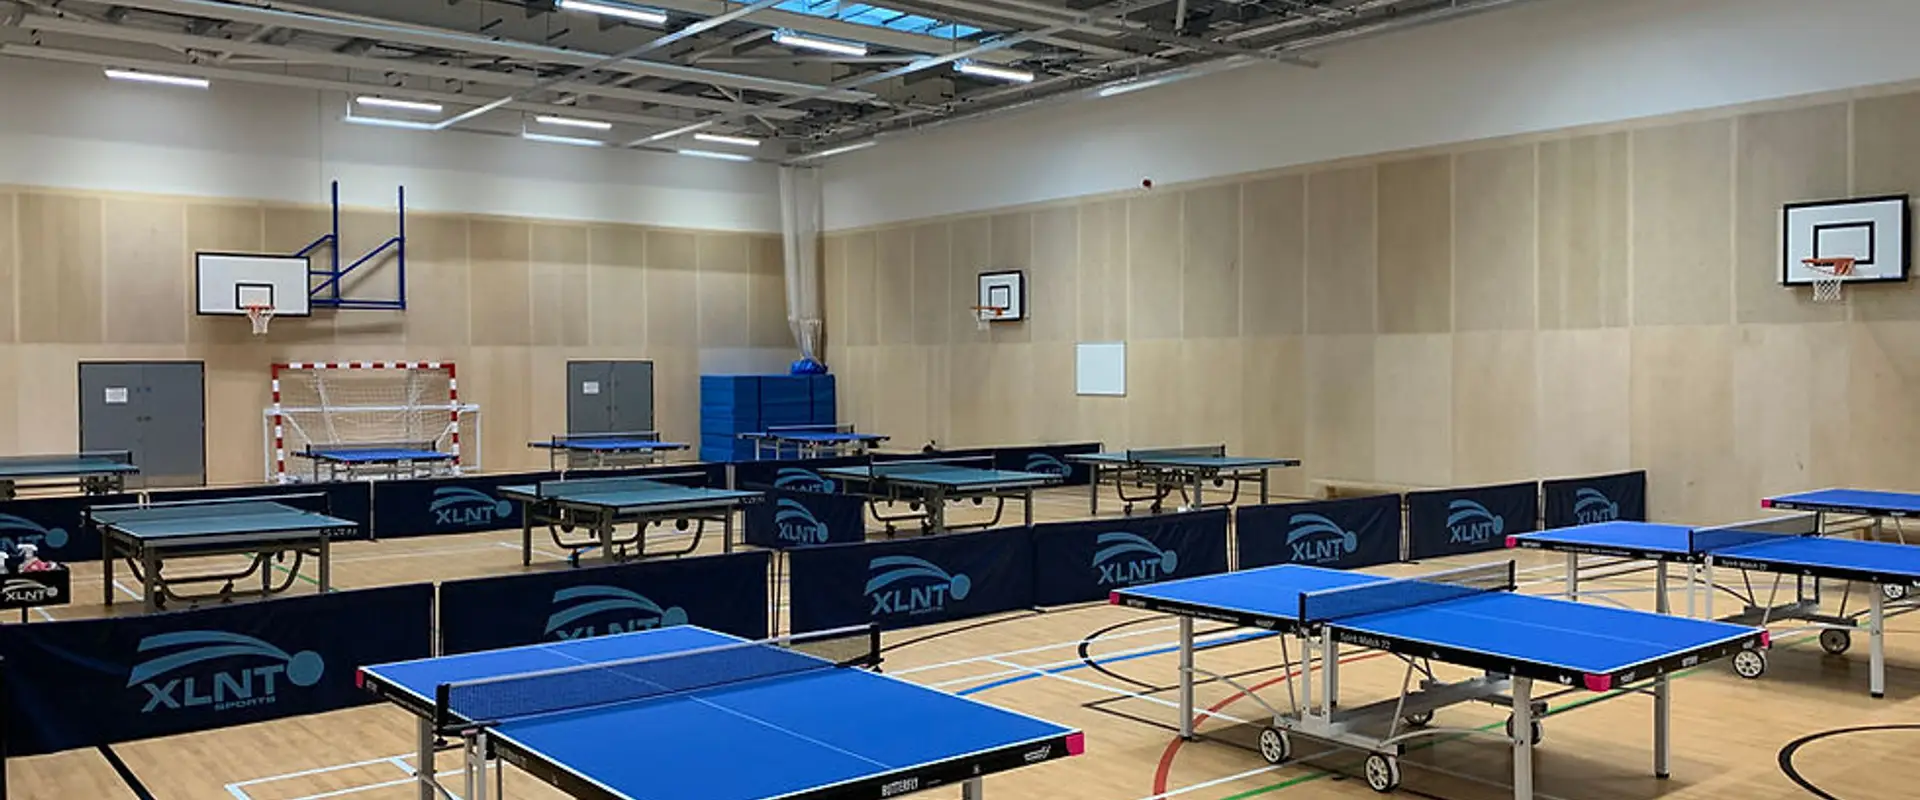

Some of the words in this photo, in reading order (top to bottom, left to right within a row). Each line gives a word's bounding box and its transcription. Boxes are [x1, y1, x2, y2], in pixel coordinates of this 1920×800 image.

[436, 506, 495, 525] XLNT
[778, 522, 817, 543] XLNT
[1450, 522, 1493, 543] XLNT
[1291, 538, 1344, 560] XLNT
[1097, 558, 1161, 585] XLNT
[4, 590, 45, 602] XLNT
[871, 583, 950, 615] XLNT
[141, 664, 285, 713] XLNT
[214, 695, 276, 712] SPORTS
[881, 776, 919, 797] BUTTERFLY
